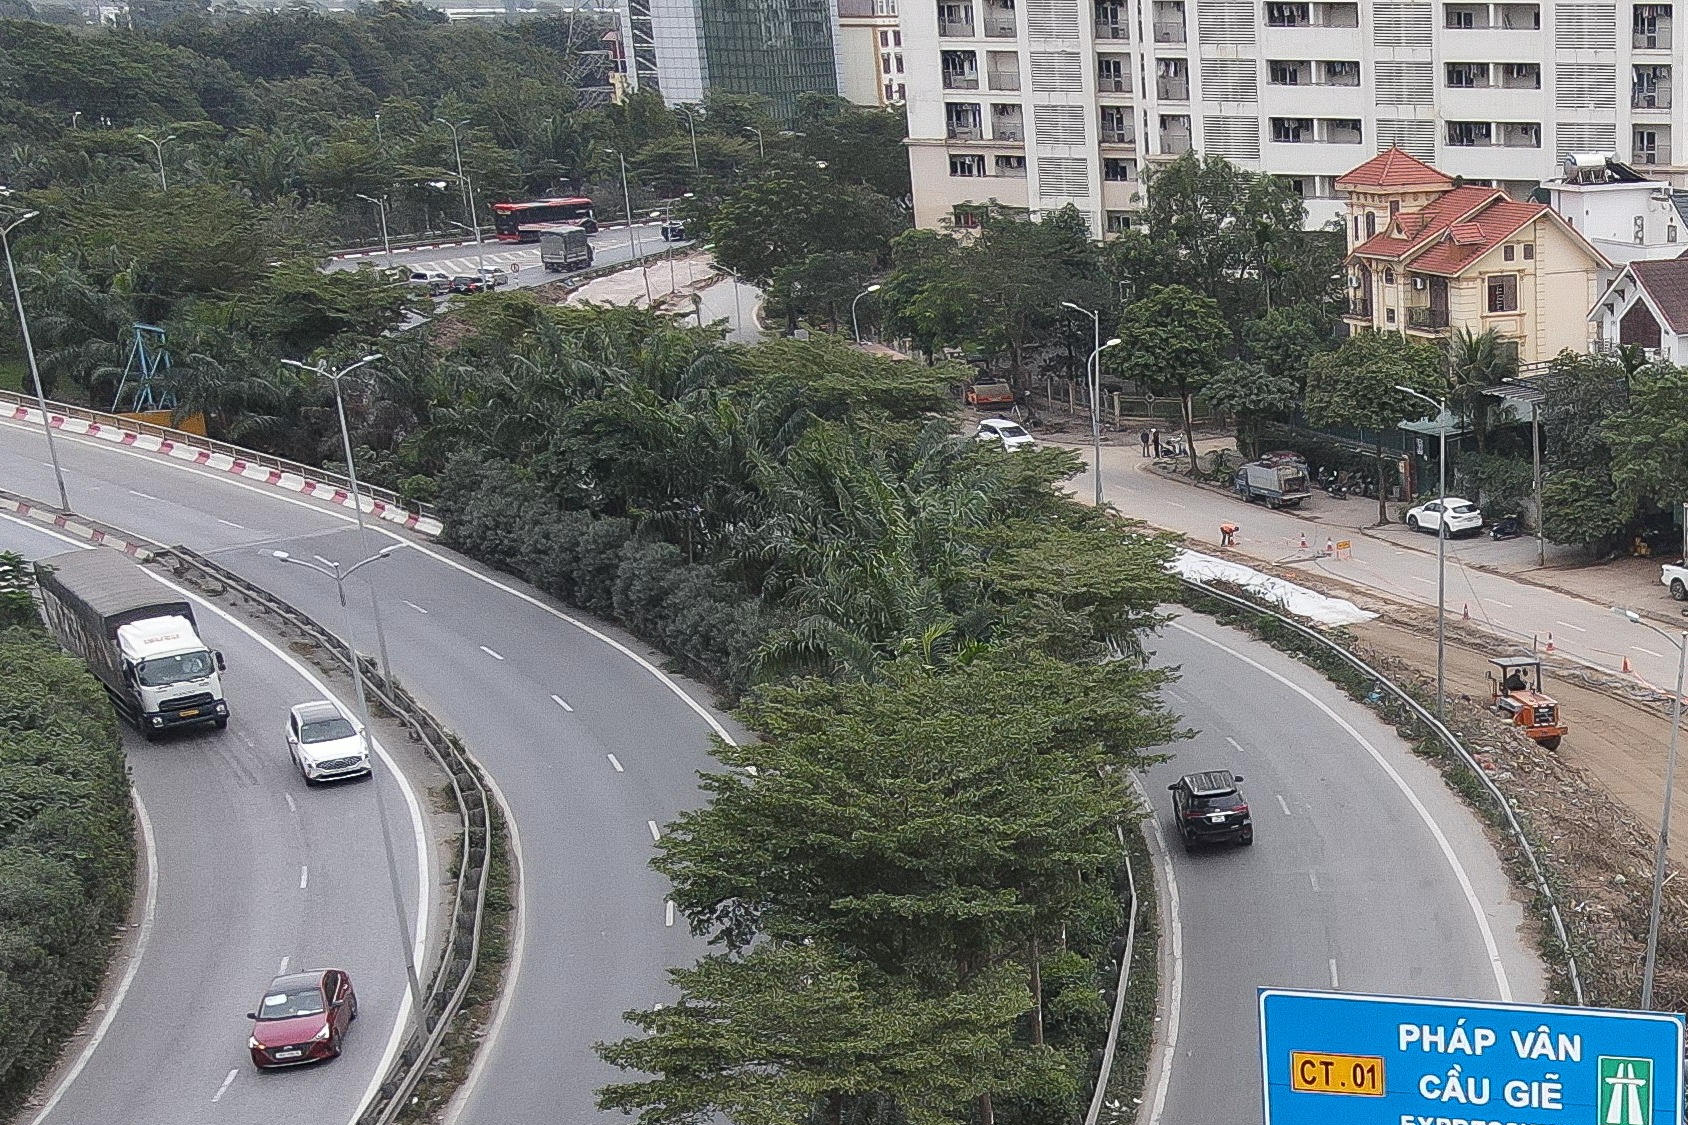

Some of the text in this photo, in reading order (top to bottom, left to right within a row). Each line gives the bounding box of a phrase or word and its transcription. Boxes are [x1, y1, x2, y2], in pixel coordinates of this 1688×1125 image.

[1399, 1018, 1582, 1062] PHÁP VÂN
[1419, 1063, 1564, 1110] CẦU GIẼ
